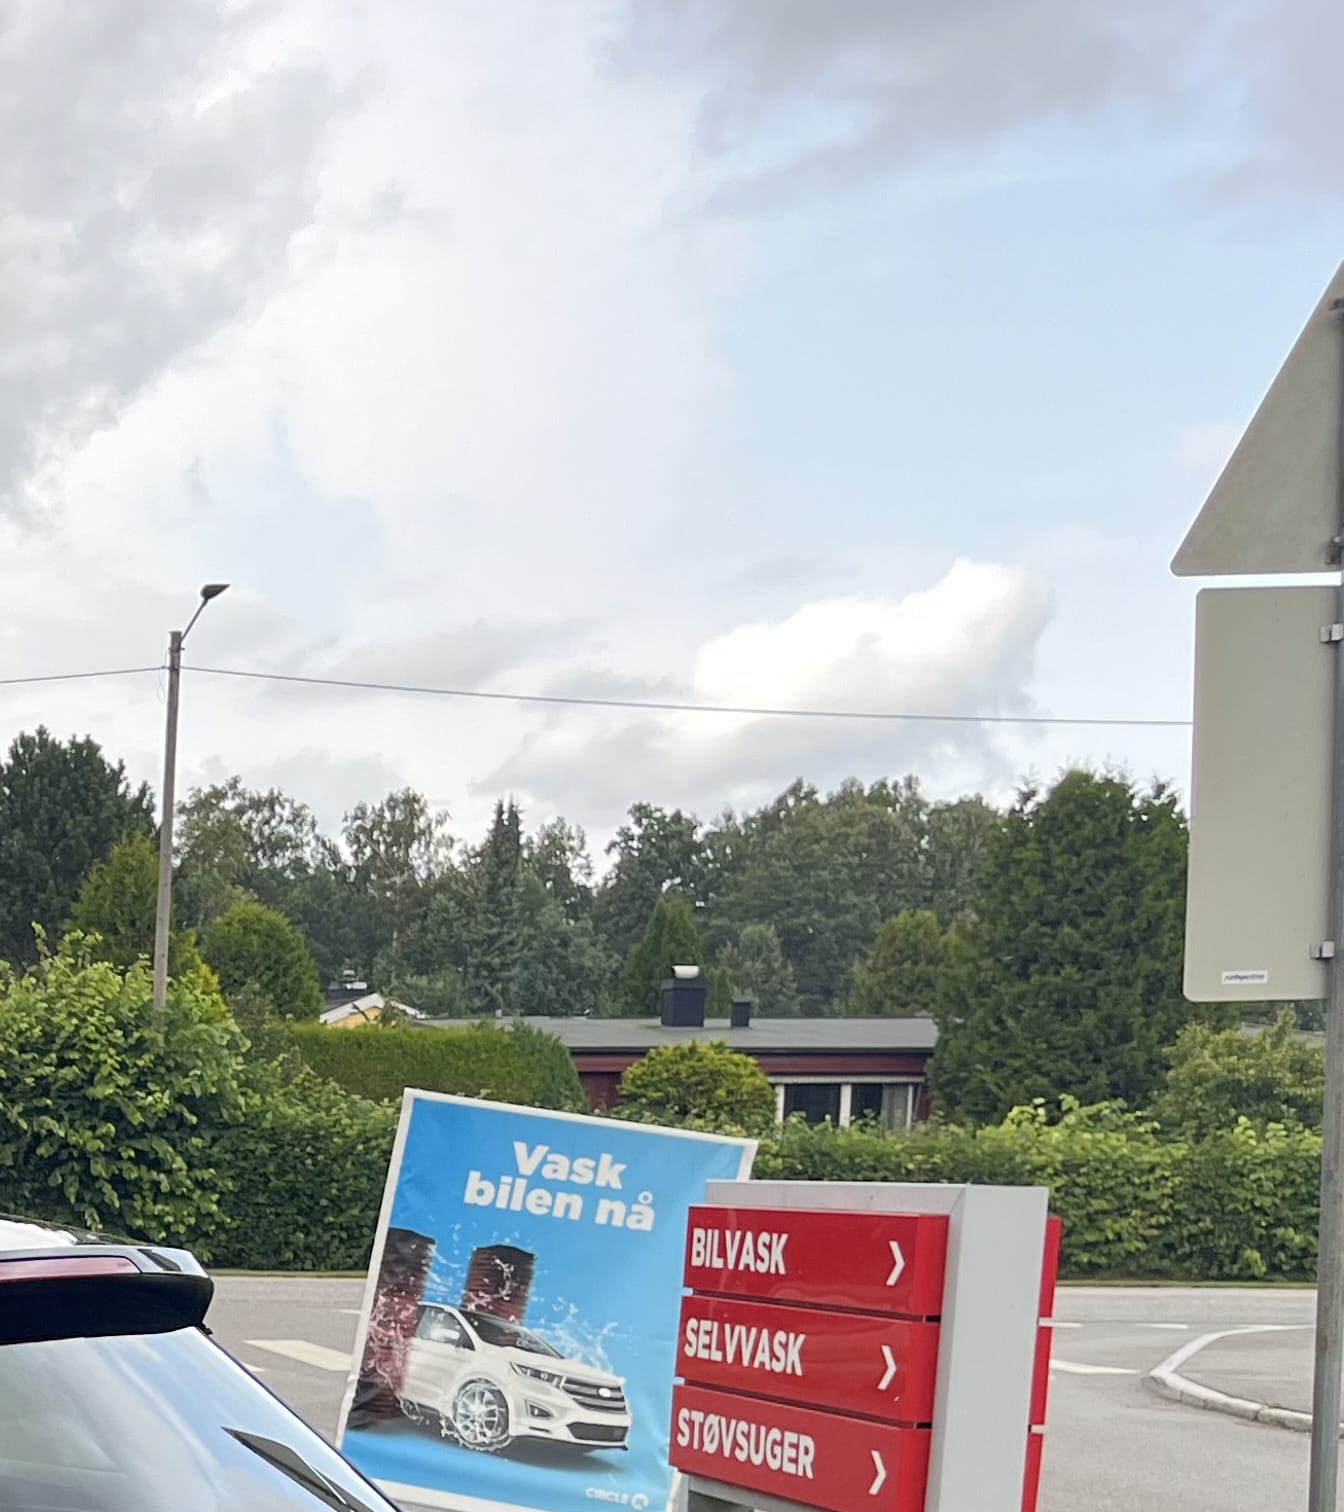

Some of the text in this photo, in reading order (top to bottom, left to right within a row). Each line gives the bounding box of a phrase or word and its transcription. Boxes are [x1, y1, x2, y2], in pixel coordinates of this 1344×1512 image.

[513, 1141, 627, 1190] Vask
[463, 1170, 655, 1232] bilen nå
[691, 1227, 788, 1275] BILVASK
[684, 1317, 806, 1376] SELVVASK
[676, 1408, 815, 1479] STØVSUGER
[585, 1487, 629, 1505] CIRCLE
